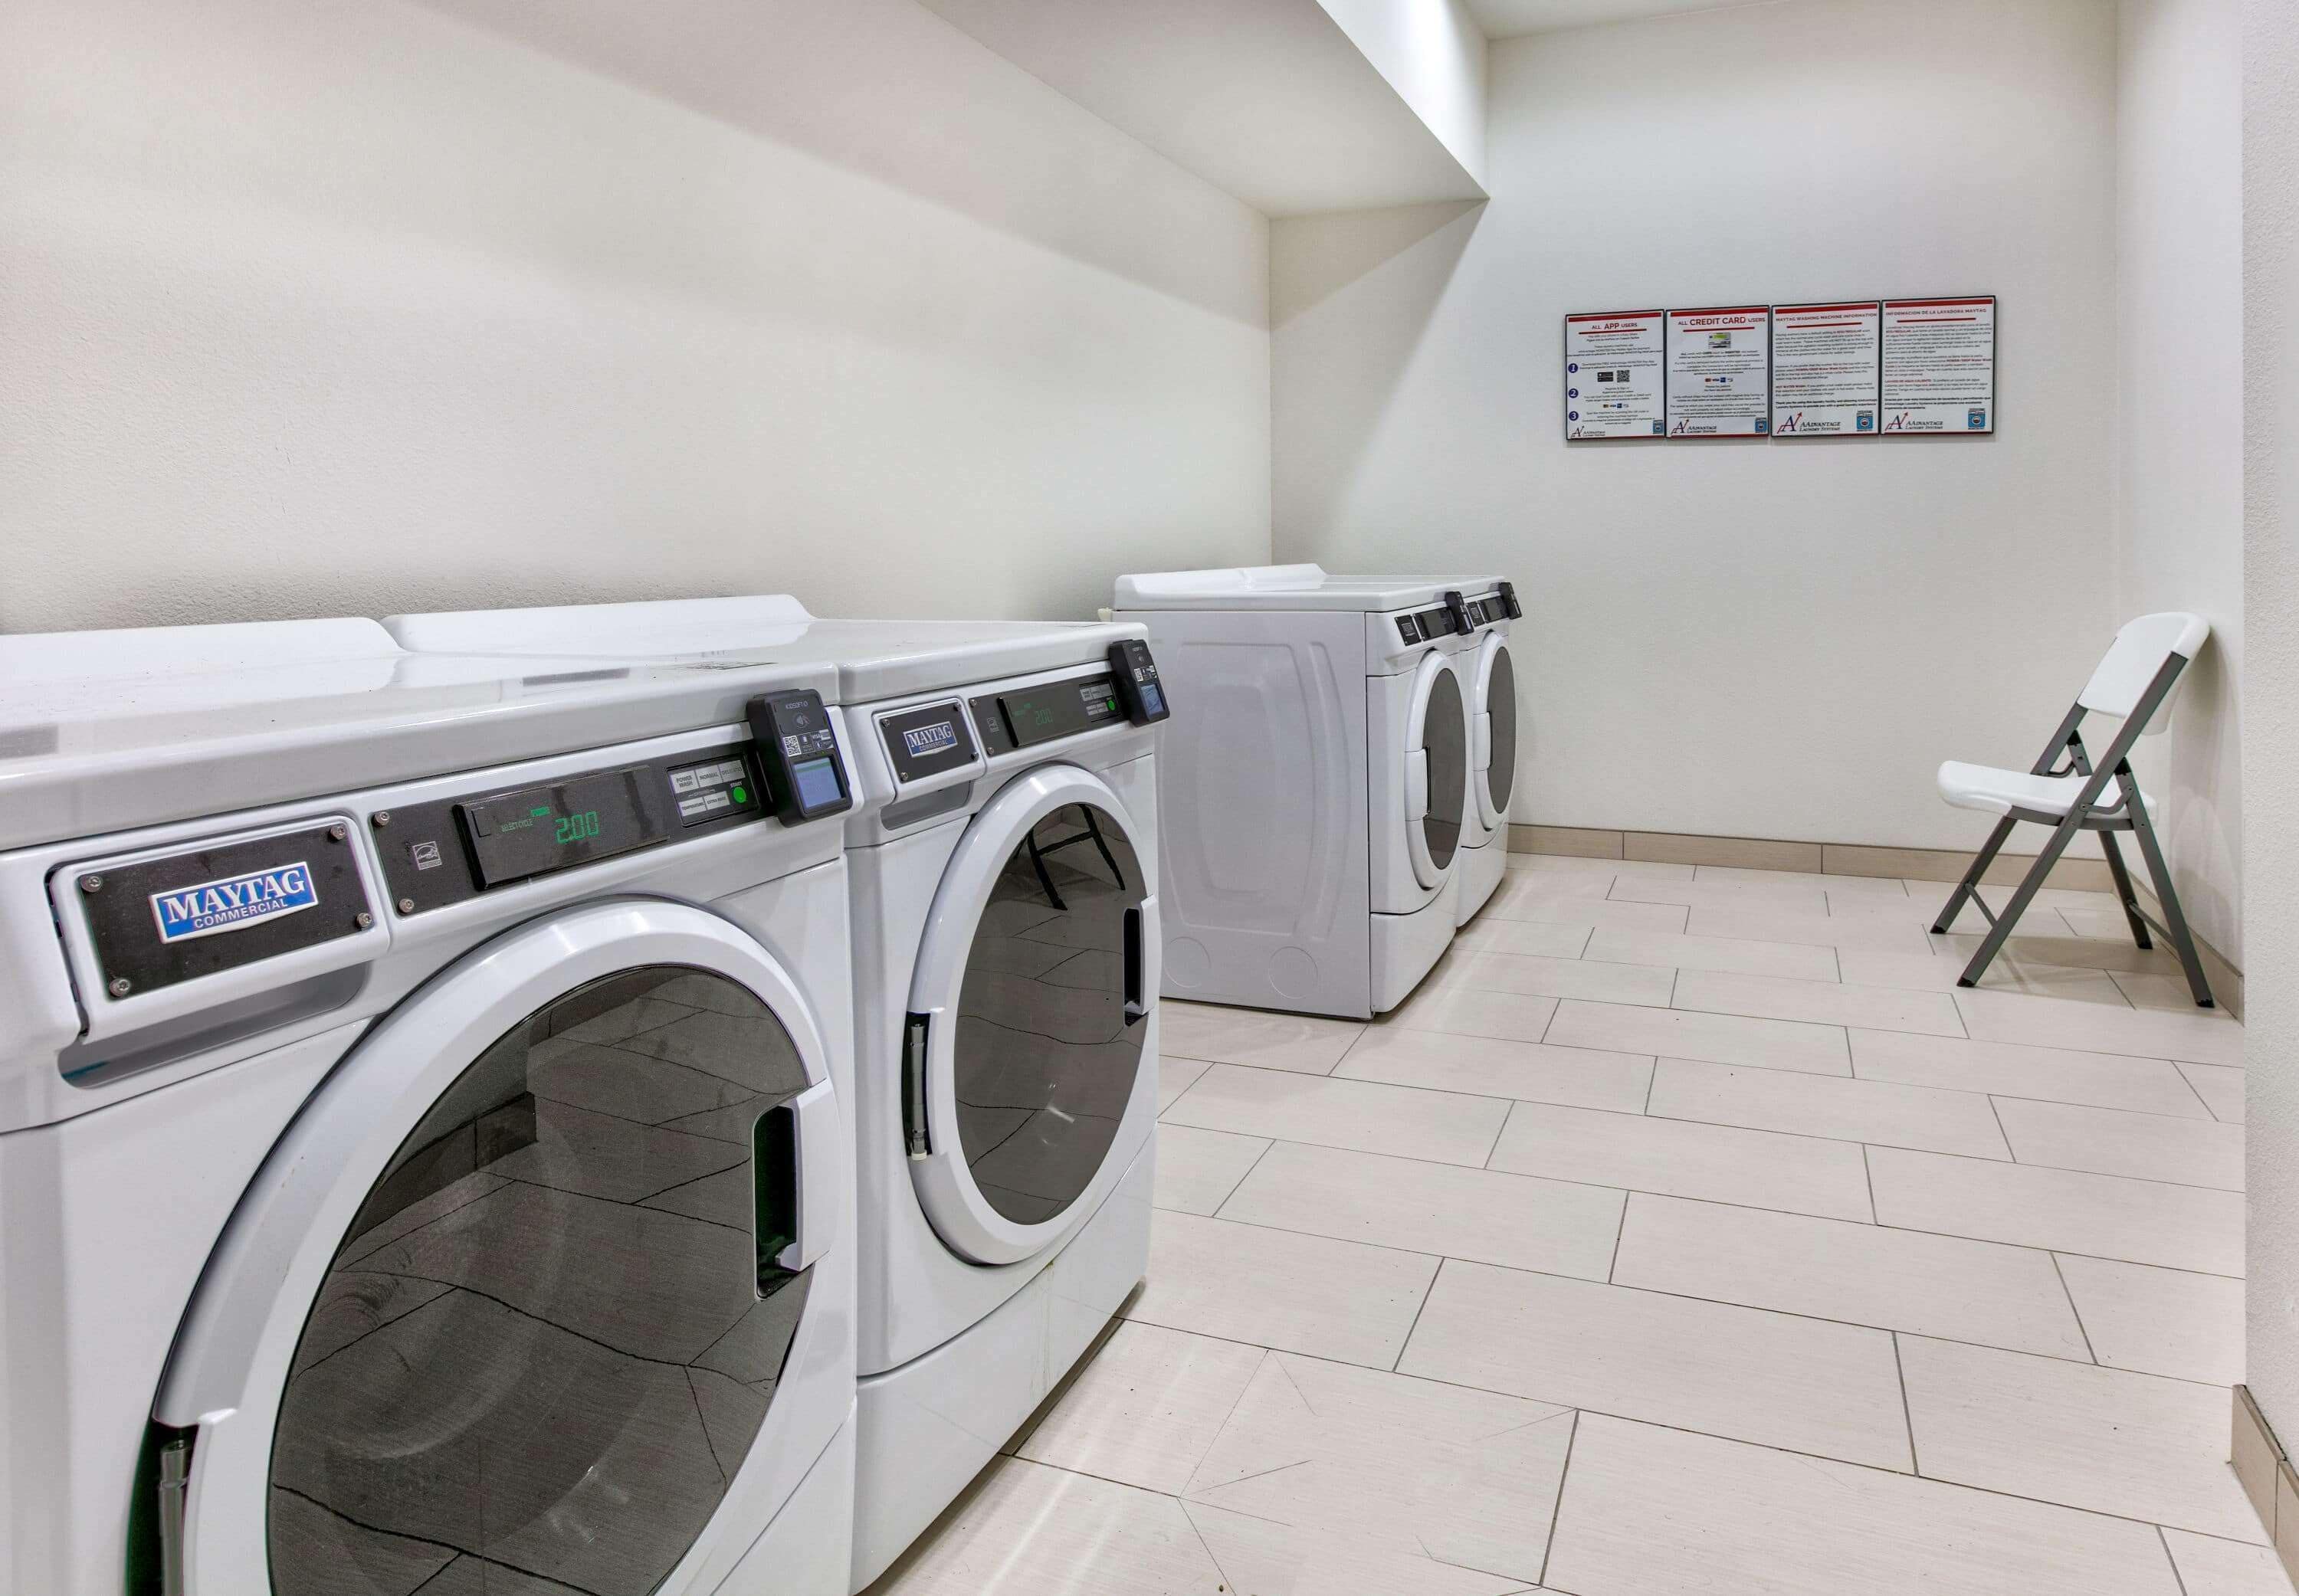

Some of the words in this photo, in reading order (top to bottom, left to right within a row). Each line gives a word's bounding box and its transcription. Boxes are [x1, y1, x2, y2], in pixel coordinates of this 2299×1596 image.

[907, 725, 952, 747] MAYTAG
[920, 740, 948, 751] COMMERCIAL
[501, 821, 518, 833] SELECT
[163, 870, 304, 923] MAYTAG
[195, 900, 288, 928] COMMERCIAL
